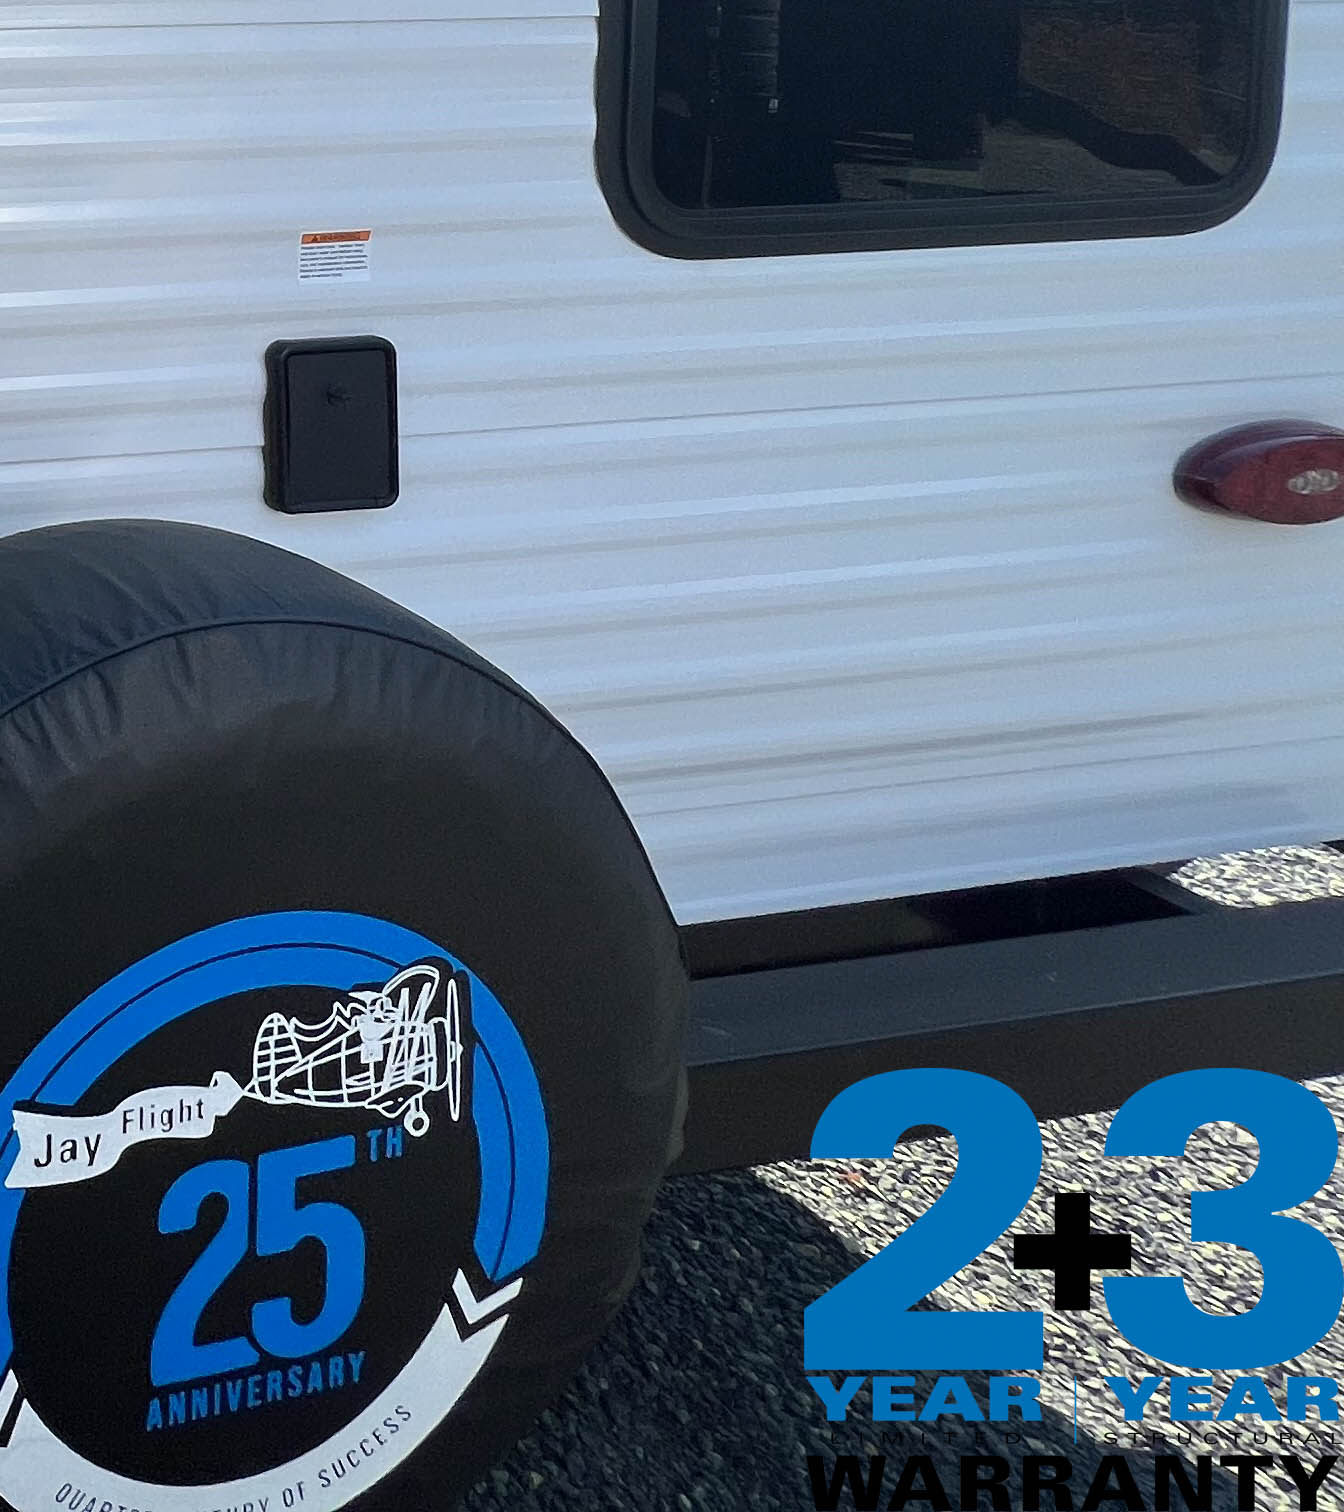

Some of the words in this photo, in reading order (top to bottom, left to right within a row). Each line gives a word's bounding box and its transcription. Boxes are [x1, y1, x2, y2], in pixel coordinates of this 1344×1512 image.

[34, 1133, 102, 1168] Jay
[122, 1097, 205, 1135] Flight
[146, 1351, 367, 1433] ANNIVERSARY
[55, 1482, 154, 1512] QUAR
[283, 1482, 305, 1507] OF
[317, 1405, 412, 1489] SUCCESS
